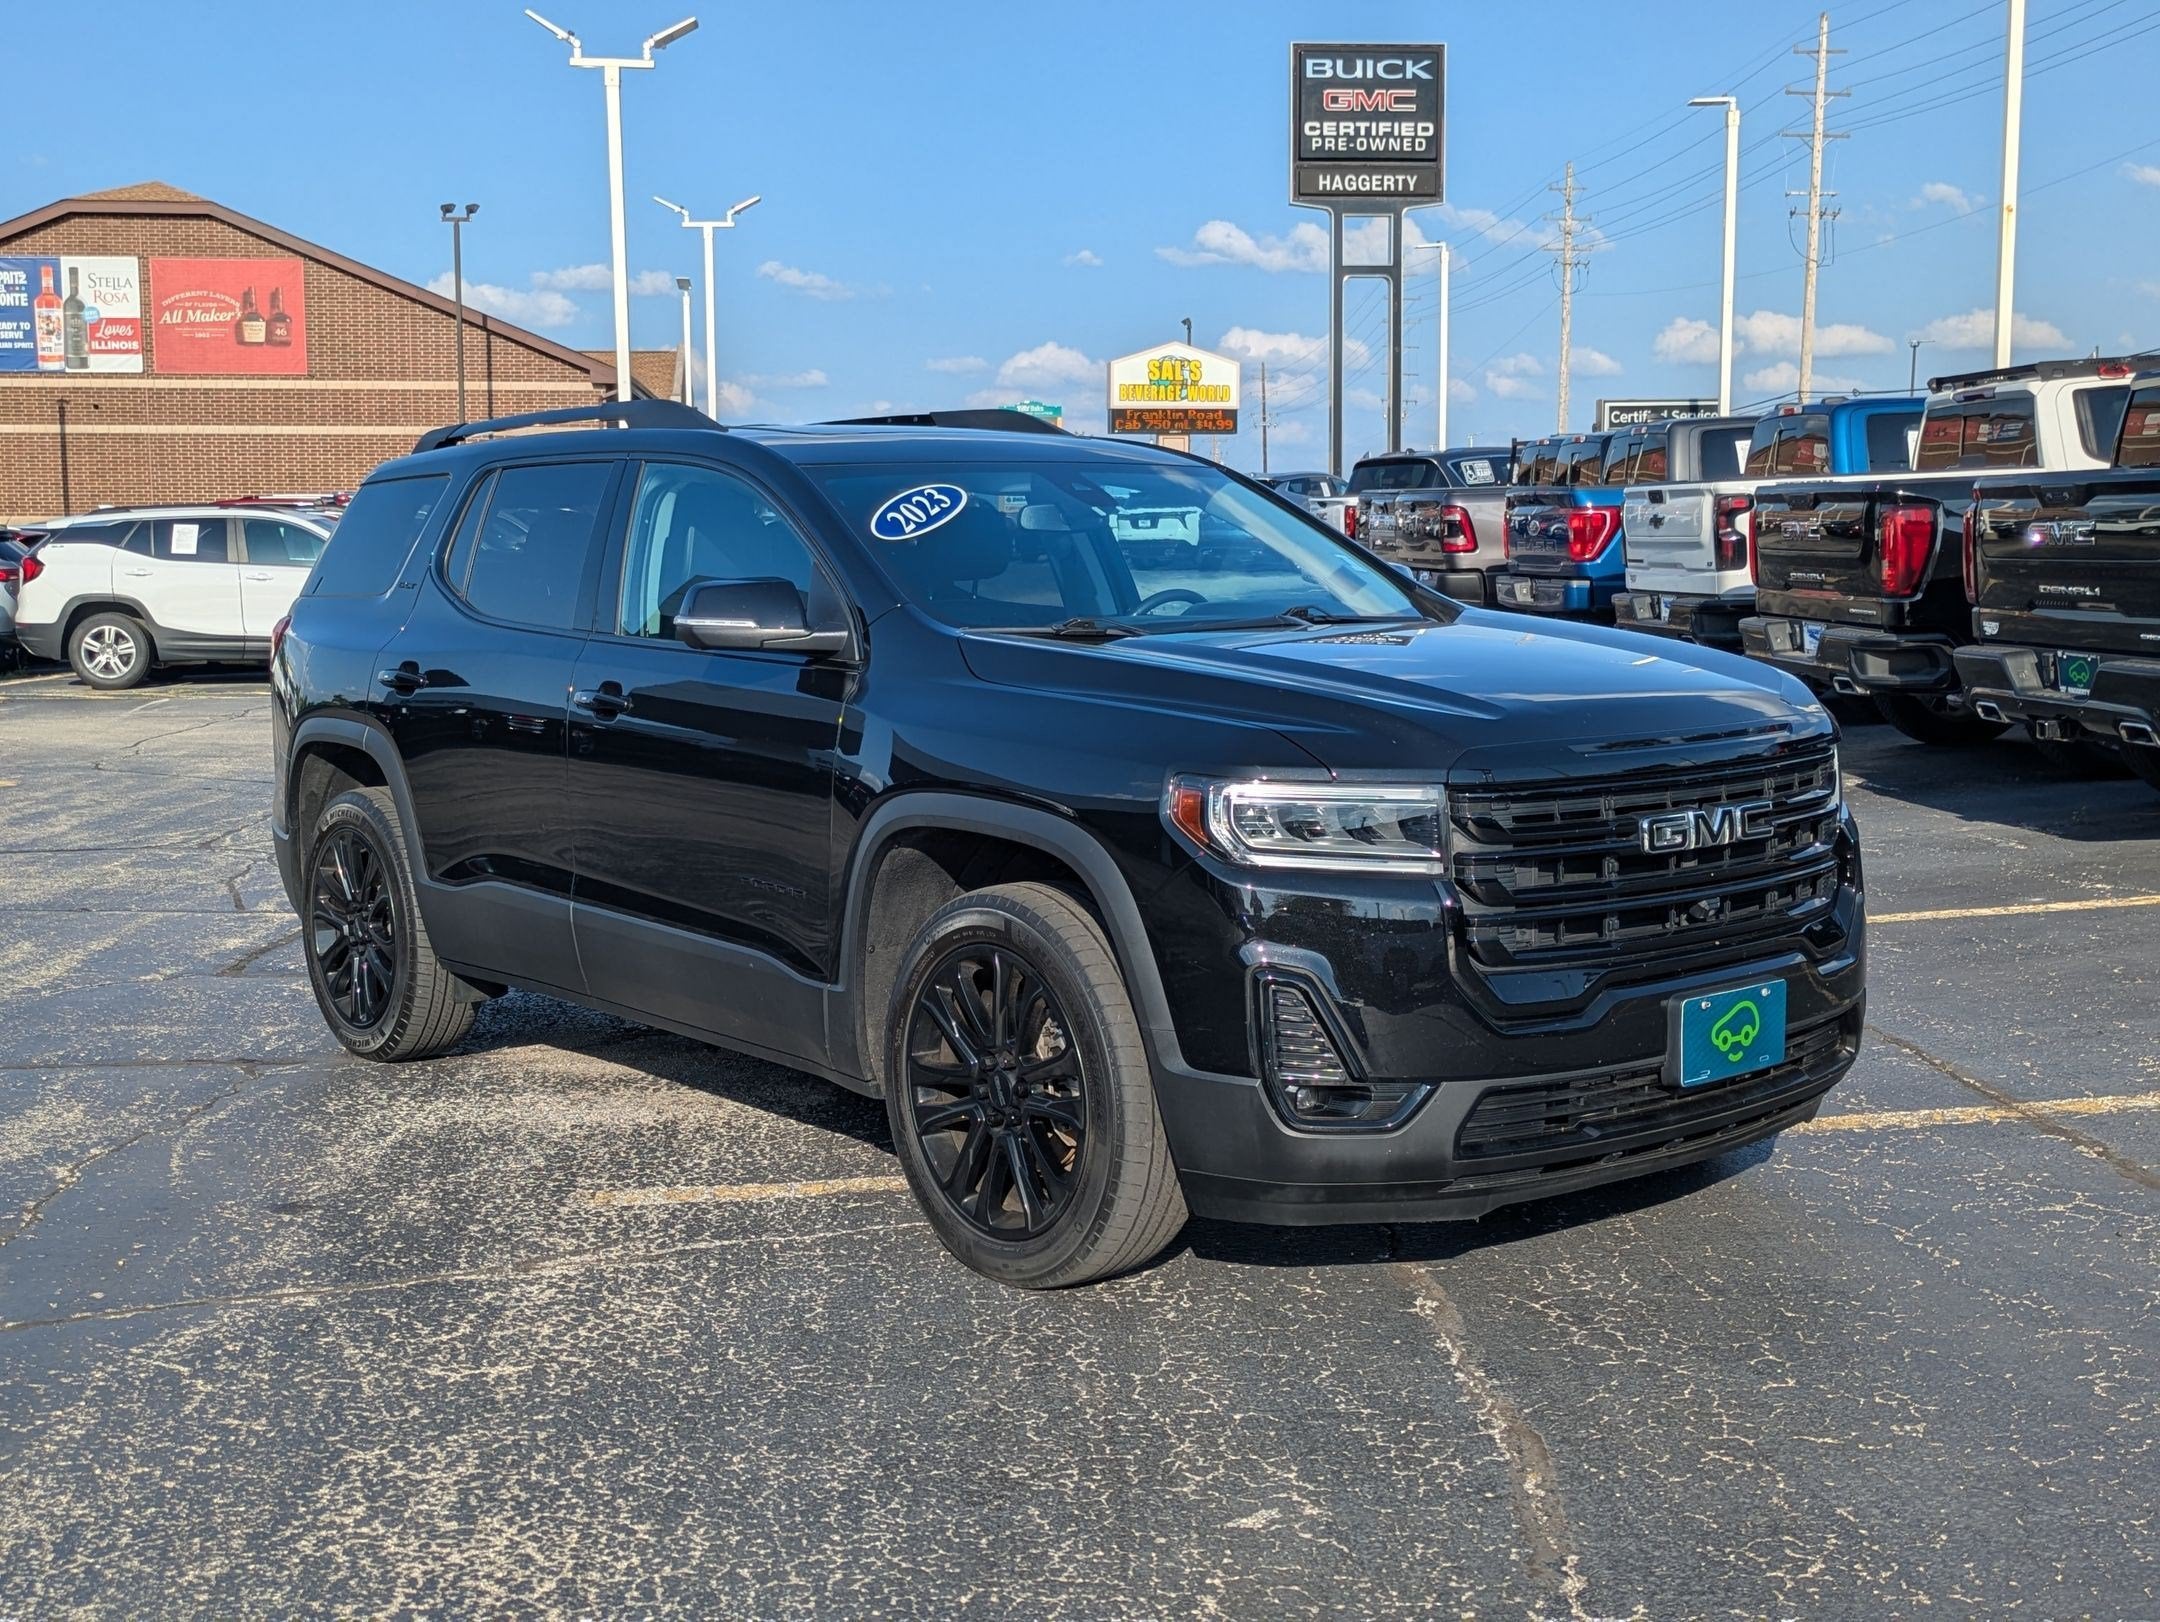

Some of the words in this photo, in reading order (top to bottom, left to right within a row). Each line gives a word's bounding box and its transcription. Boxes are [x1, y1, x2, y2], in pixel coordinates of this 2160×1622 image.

[1305, 58, 1434, 79] BUICK
[1322, 88, 1417, 112] GMC
[1303, 121, 1435, 137] CERTIFIED
[1311, 137, 1427, 151] PRE-OWNED
[1318, 174, 1418, 191] HAGGERTY
[88, 272, 133, 290] STELLA
[93, 289, 130, 306] ROSA
[161, 290, 208, 306] DIFFERENT
[159, 309, 183, 324] All
[184, 307, 243, 323] Maker's
[0, 322, 17, 330] ADY
[19, 321, 31, 330] TO
[95, 318, 135, 339] Loves
[274, 327, 288, 336] 46
[0, 331, 24, 339] SERVE
[91, 340, 139, 350] ILLINOIS
[1147, 359, 1203, 381] SAL'S
[1119, 383, 1182, 402] BEVERAGE
[1185, 384, 1231, 402] WORLD
[1126, 409, 1185, 420] Franklin
[1187, 409, 1223, 420] Road
[1610, 409, 1668, 423] Certifd
[1115, 419, 1141, 430] Cab
[1145, 419, 1171, 430] 750
[1195, 419, 1234, 430] $4.99
[886, 488, 951, 534] 2023
[2027, 520, 2096, 546] GMC
[2038, 584, 2101, 597] DENALI
[329, 808, 361, 822] MICHELIN
[1639, 801, 1775, 854] GMC
